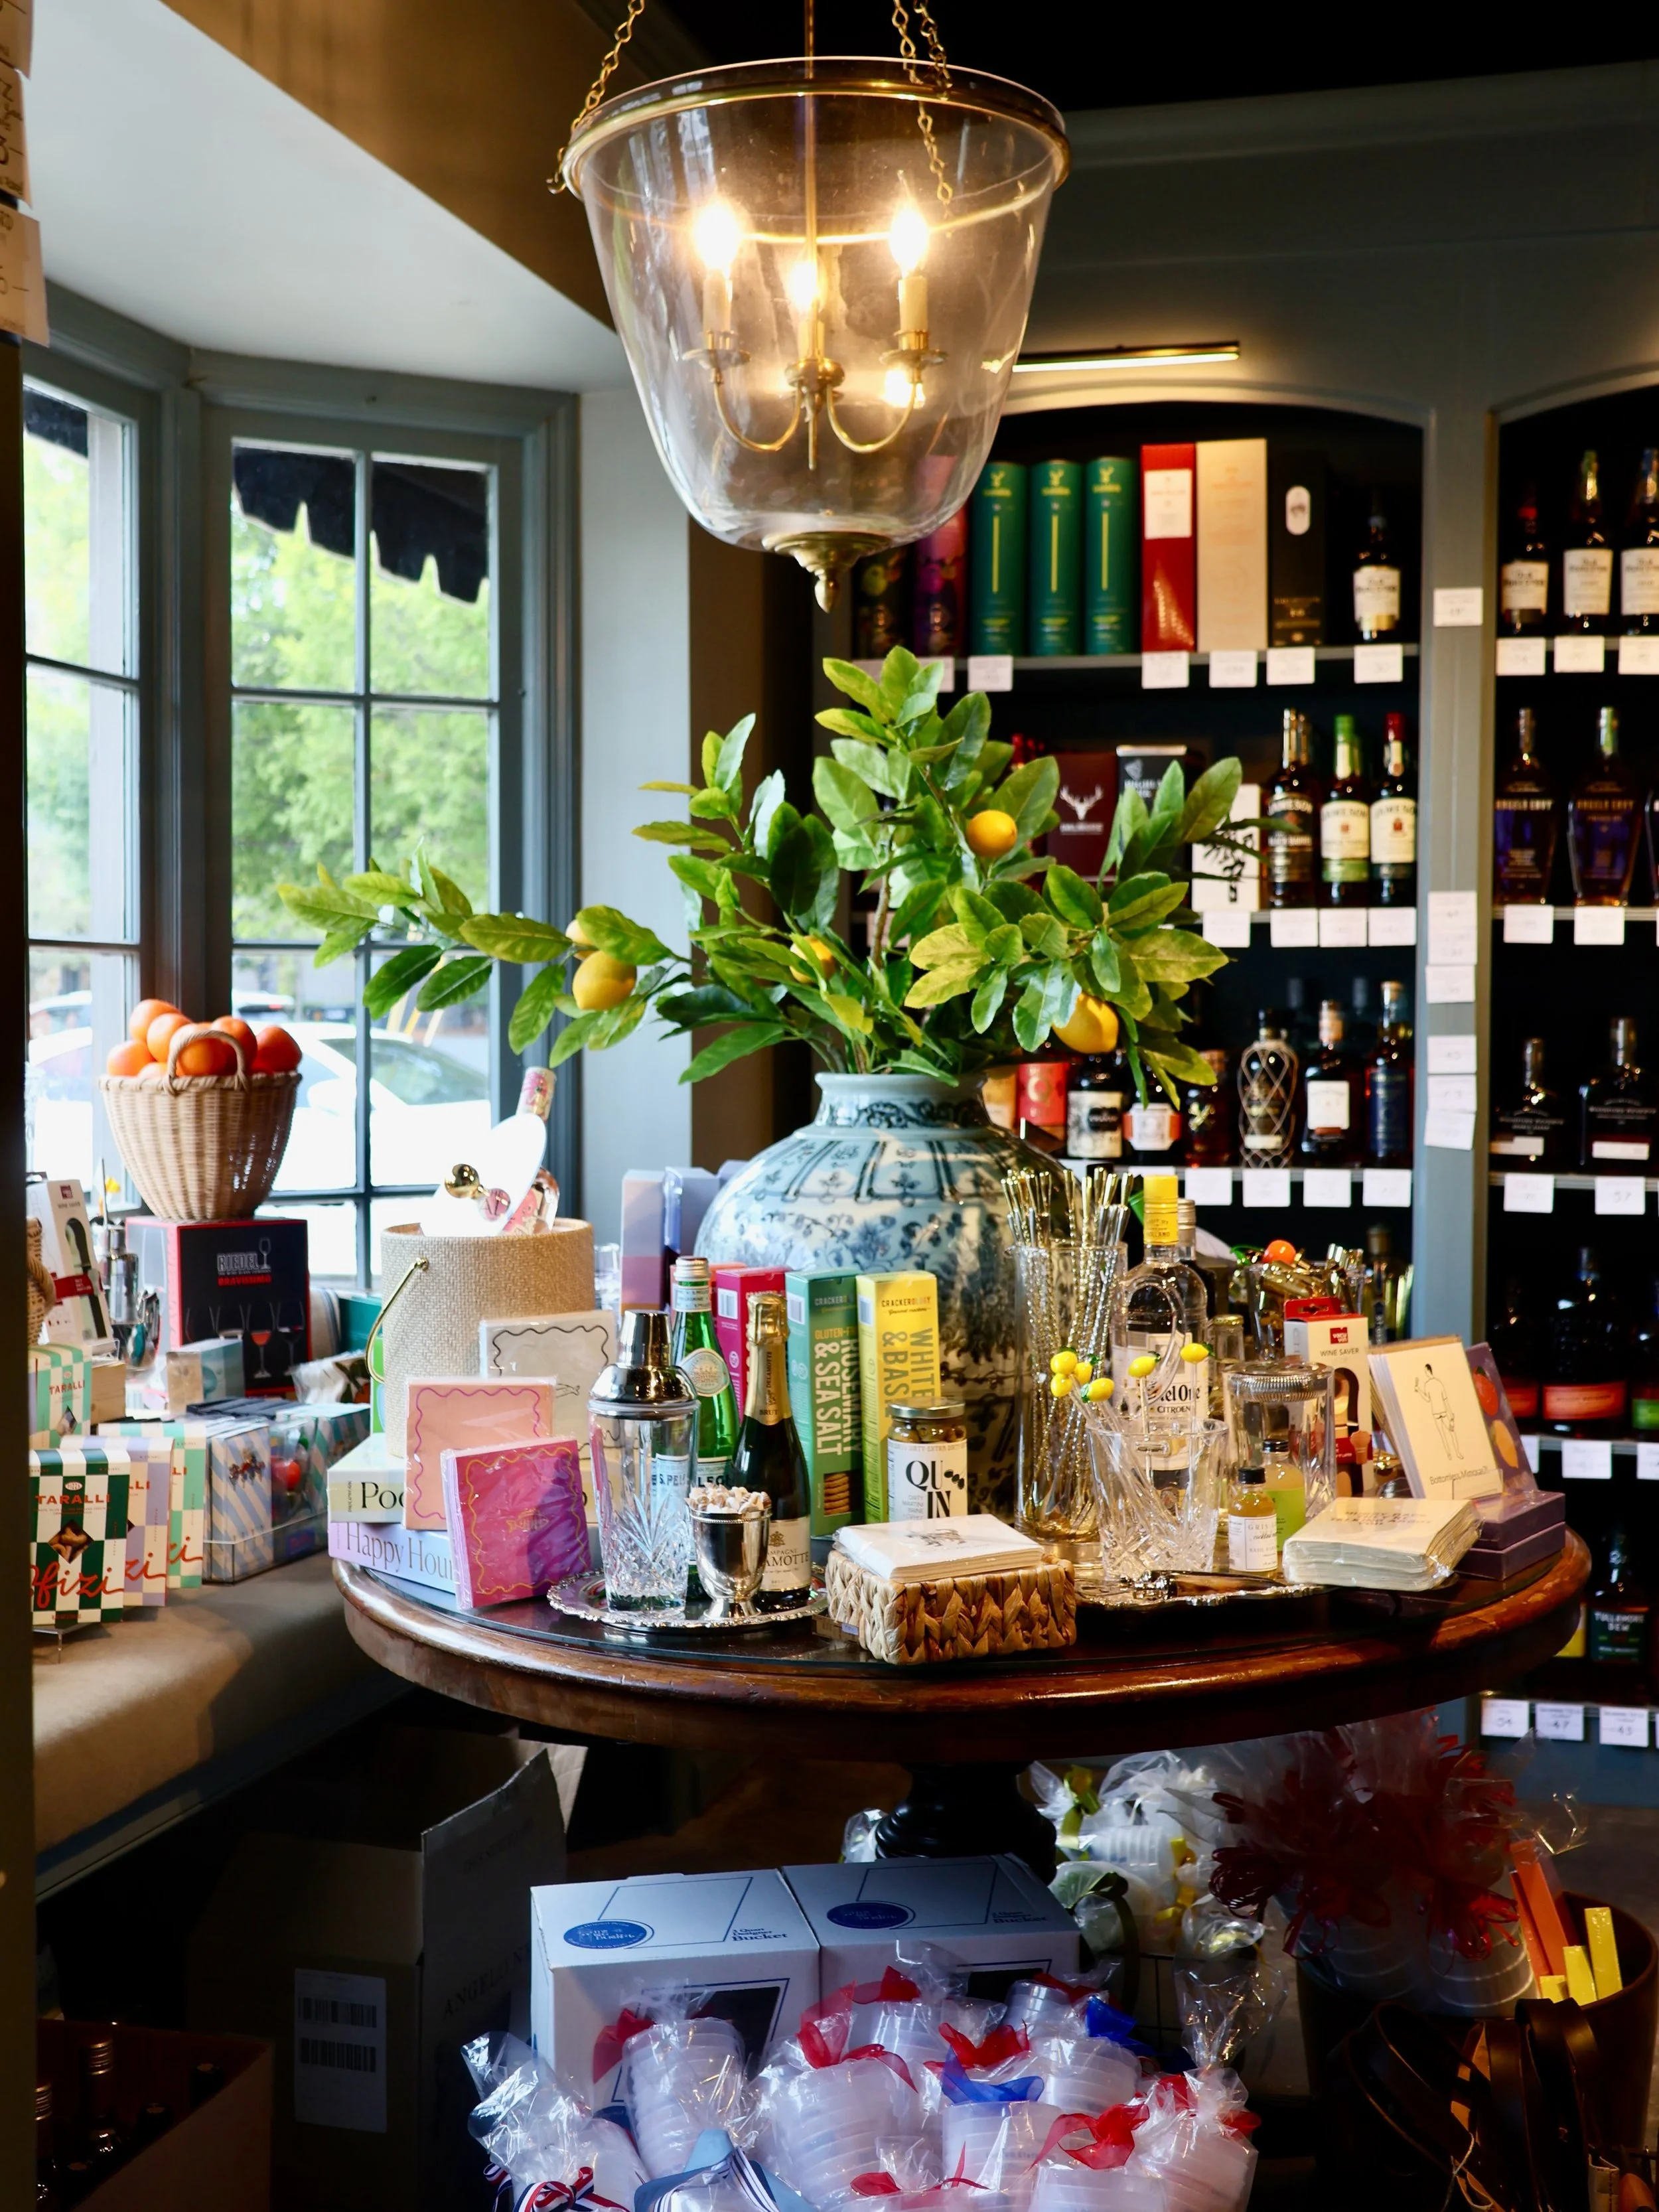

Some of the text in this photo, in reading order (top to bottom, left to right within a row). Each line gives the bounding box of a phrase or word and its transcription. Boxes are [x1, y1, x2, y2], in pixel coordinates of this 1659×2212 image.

[217, 1252, 259, 1272] RIEDEL
[814, 1342, 840, 1359] &
[48, 1380, 86, 1396] TARALLI
[814, 1361, 841, 1404] SEA
[816, 1405, 842, 1455] SALT
[35, 1493, 111, 1505] TARALLI
[346, 1522, 402, 1573] Happy
[766, 1551, 809, 1567] AMOTTE
[732, 1933, 788, 1942] Bucket
